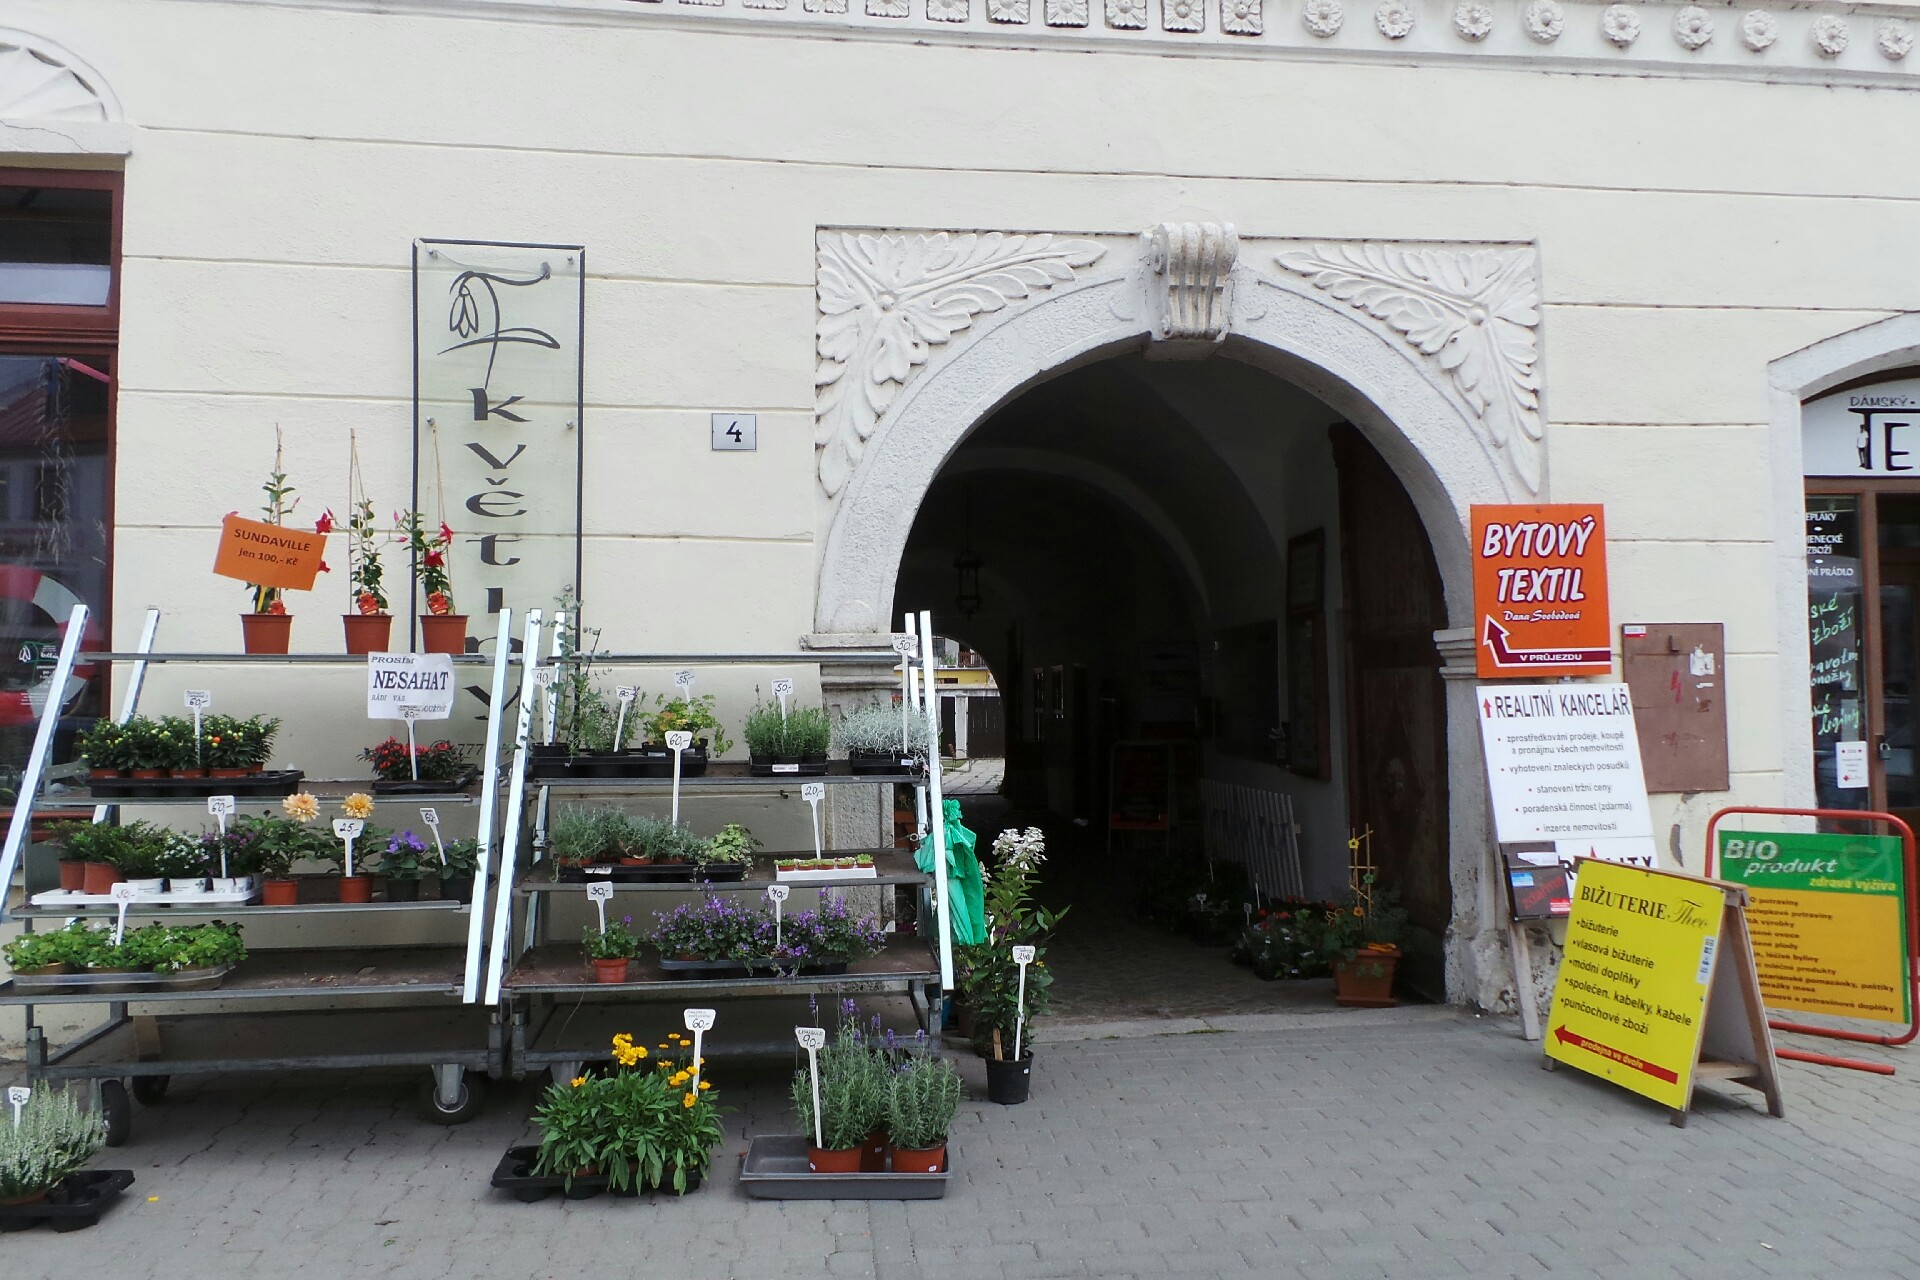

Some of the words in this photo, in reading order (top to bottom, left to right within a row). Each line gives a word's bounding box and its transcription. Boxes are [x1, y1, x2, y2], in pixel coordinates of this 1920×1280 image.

[1850, 395, 1908, 407] DÁMSKÝ
[725, 420, 743, 443] 4
[1847, 407, 1920, 472] TE
[234, 528, 311, 552] SUNDAVILLE
[1482, 515, 1596, 557] BYTOVÝ
[238, 547, 256, 559] jen
[258, 552, 284, 565] 100,-
[285, 557, 298, 566] Kč
[1820, 565, 1854, 577] PRÁDLO
[1497, 567, 1585, 604] TEXTIL
[1503, 610, 1530, 622] Dana
[1530, 609, 1581, 623] Svobodová
[1529, 652, 1582, 661] PRŮJEZDU
[372, 670, 449, 690] NESAHAT
[1494, 690, 1555, 718] REALITNÍ
[1559, 688, 1631, 716] KANCELÁŘ
[669, 733, 690, 747] 60,-
[1601, 731, 1624, 741] koupě
[1518, 745, 1555, 755] pronájmu
[1556, 744, 1578, 753] všech
[1553, 762, 1595, 772] znaleckých
[805, 786, 824, 796] 20,-
[1594, 784, 1611, 794] ceny
[211, 802, 233, 815] 60,-
[339, 821, 360, 835] 25,-
[1543, 823, 1571, 832] inzerce
[1723, 838, 1779, 861] BIO
[1744, 859, 1839, 877] produkt
[590, 886, 609, 898] 30,-
[1580, 885, 1667, 921] BIŽUTERIE
[1580, 919, 1619, 938] bižuterie
[1612, 947, 1655, 970] bižuterie
[692, 1017, 710, 1029] 60,-
[1563, 997, 1620, 1025] punčochové
[1622, 1016, 1649, 1035] zboží
[1656, 1003, 1692, 1027] kabele
